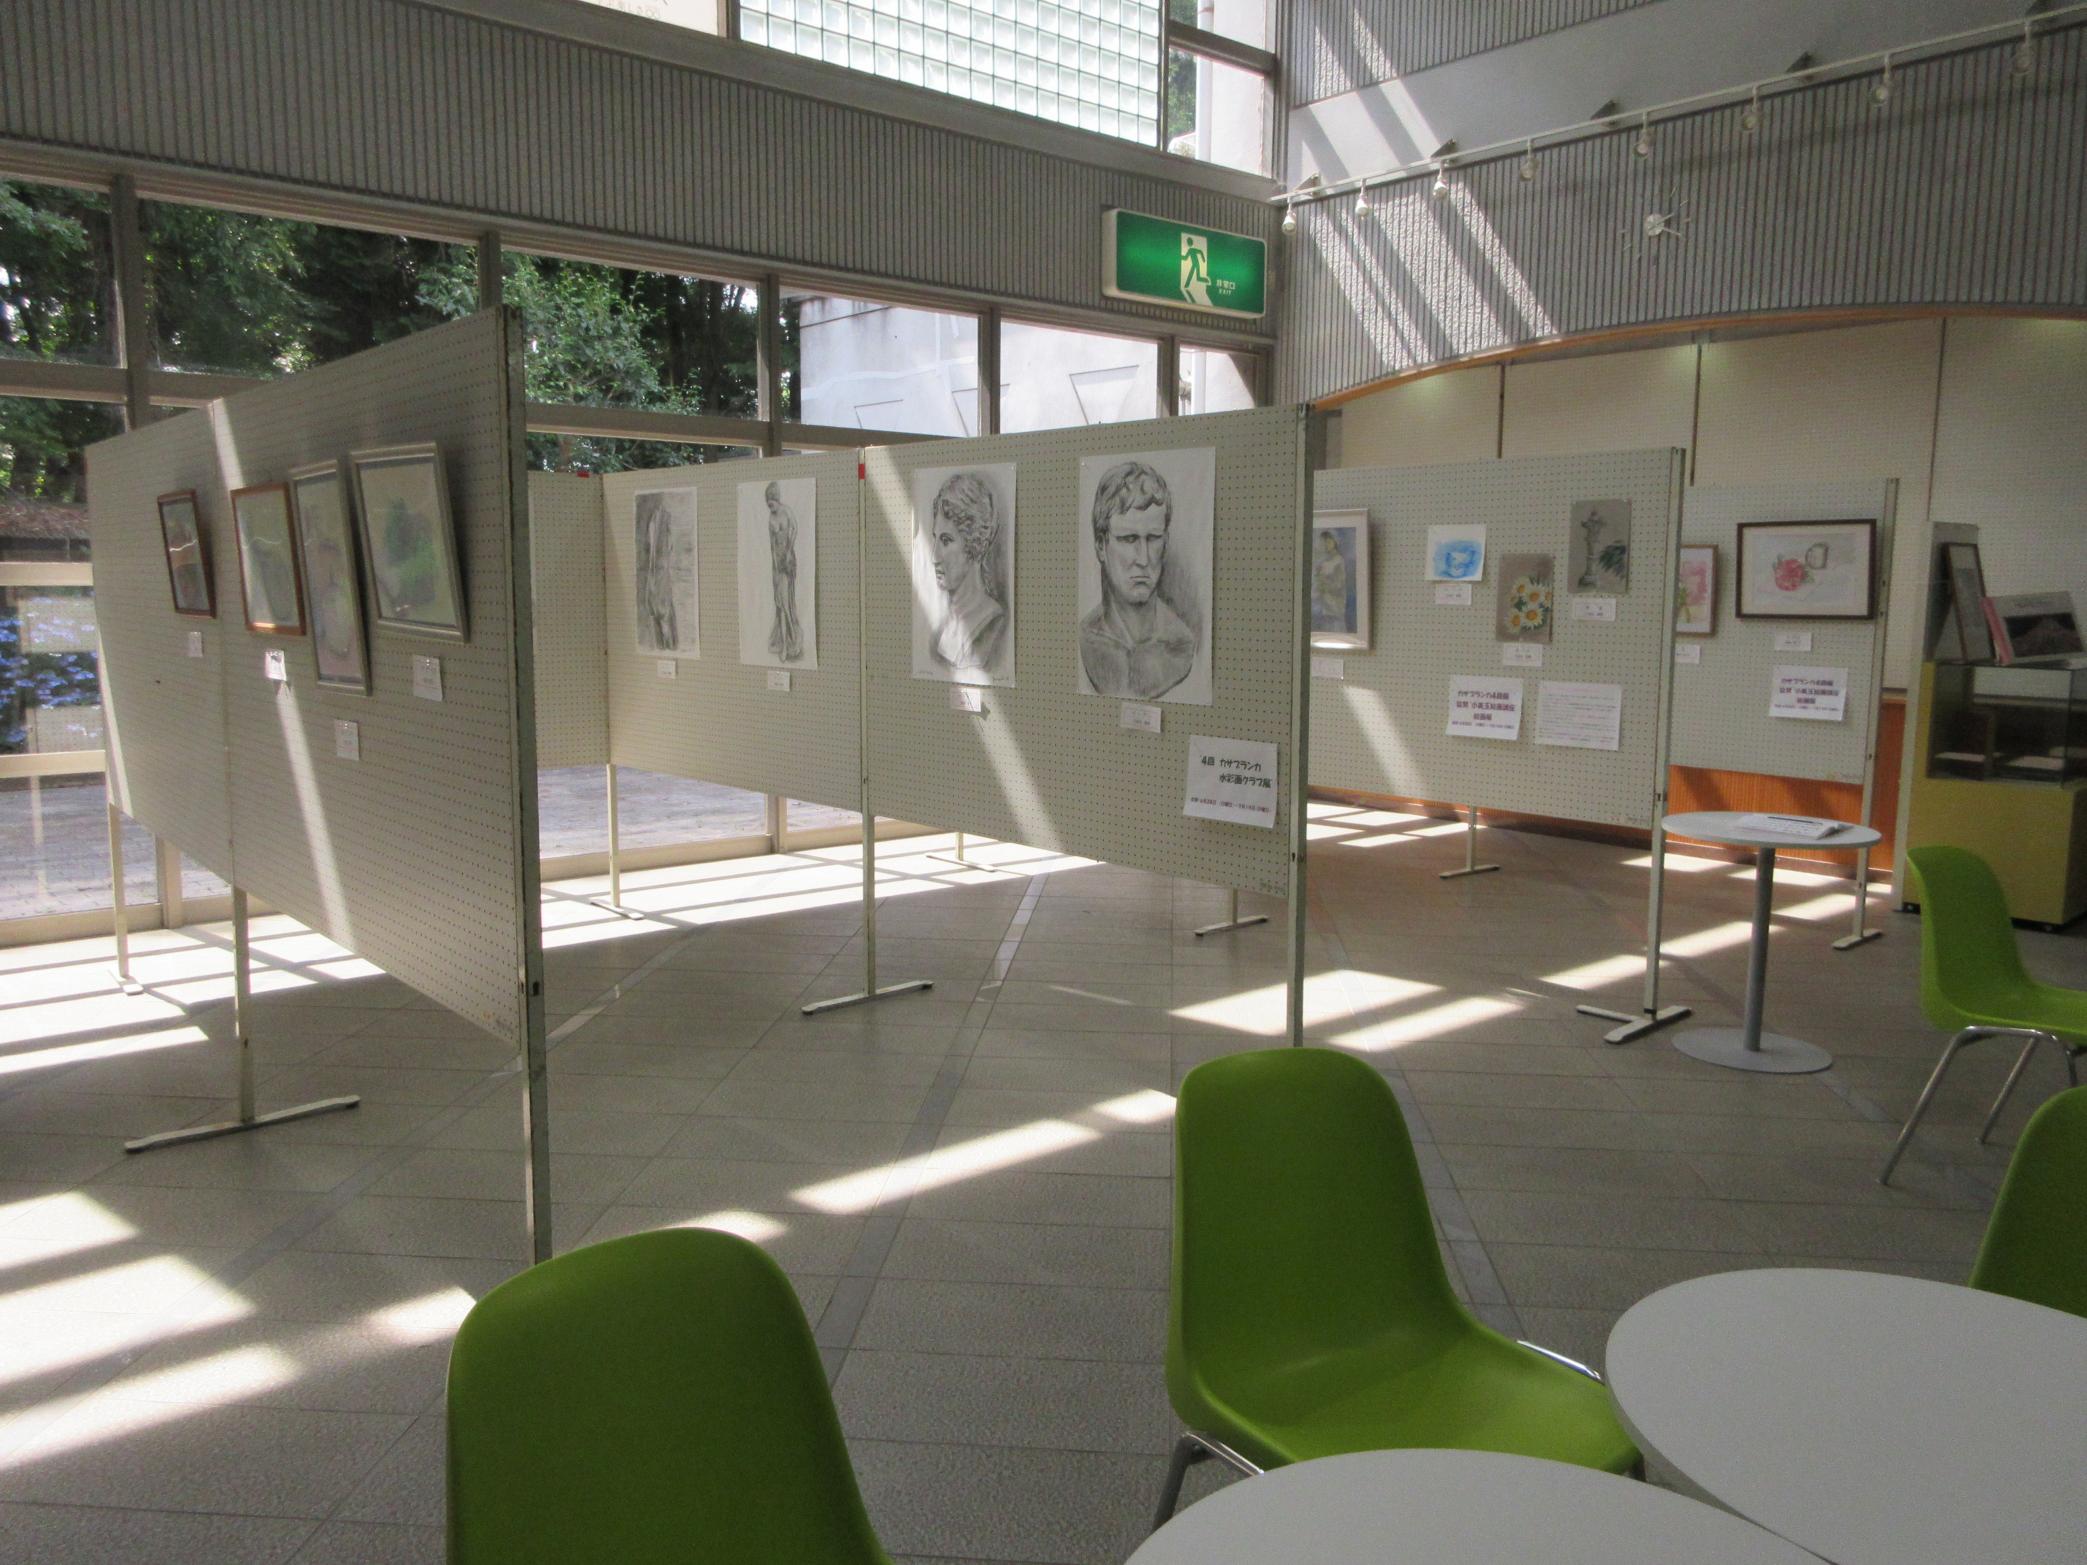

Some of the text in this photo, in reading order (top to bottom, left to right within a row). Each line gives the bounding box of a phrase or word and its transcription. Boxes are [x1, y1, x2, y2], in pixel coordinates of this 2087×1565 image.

[1219, 758, 1262, 772] カサブランカ
